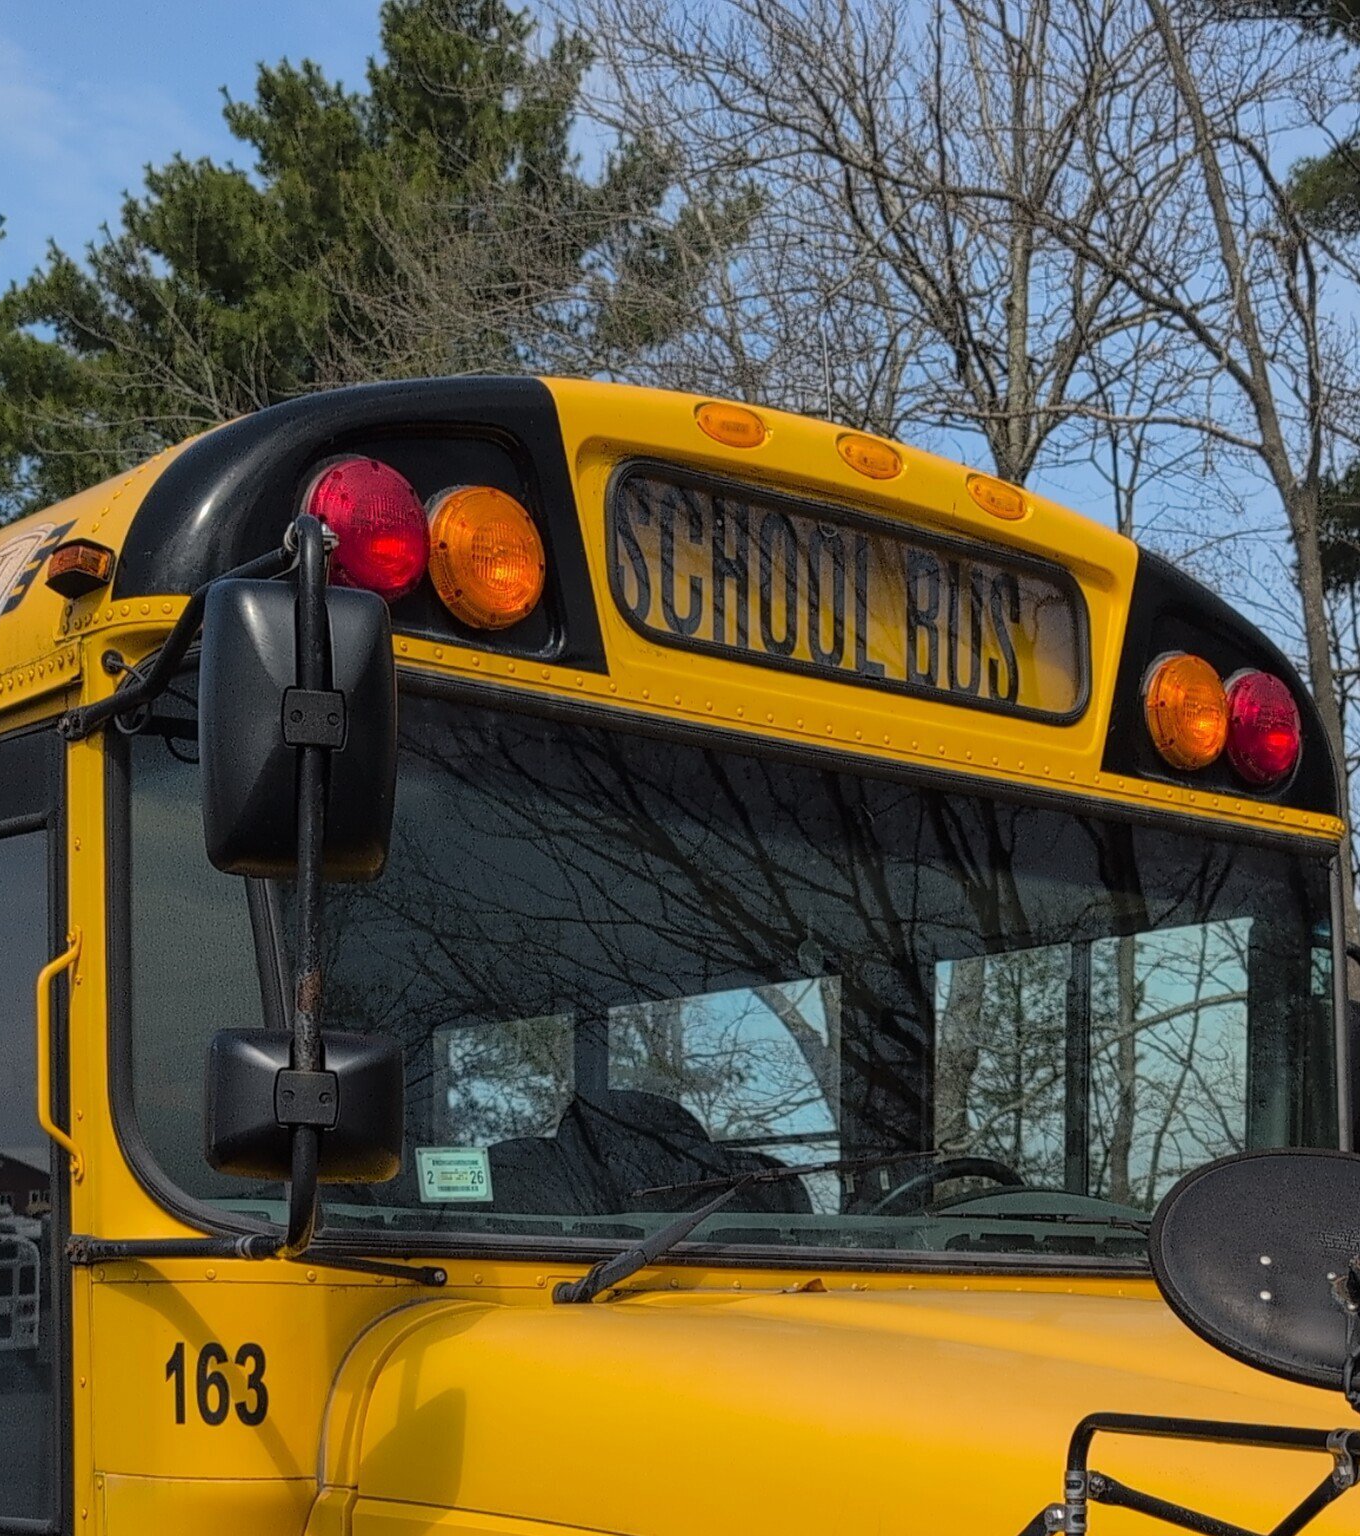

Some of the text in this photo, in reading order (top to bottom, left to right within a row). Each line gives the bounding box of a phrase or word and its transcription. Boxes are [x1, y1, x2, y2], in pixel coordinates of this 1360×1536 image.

[616, 476, 1020, 706] SCHOOL BUS
[426, 1170, 435, 1185] 2
[469, 1170, 484, 1184] 26
[165, 1341, 269, 1427] 163
